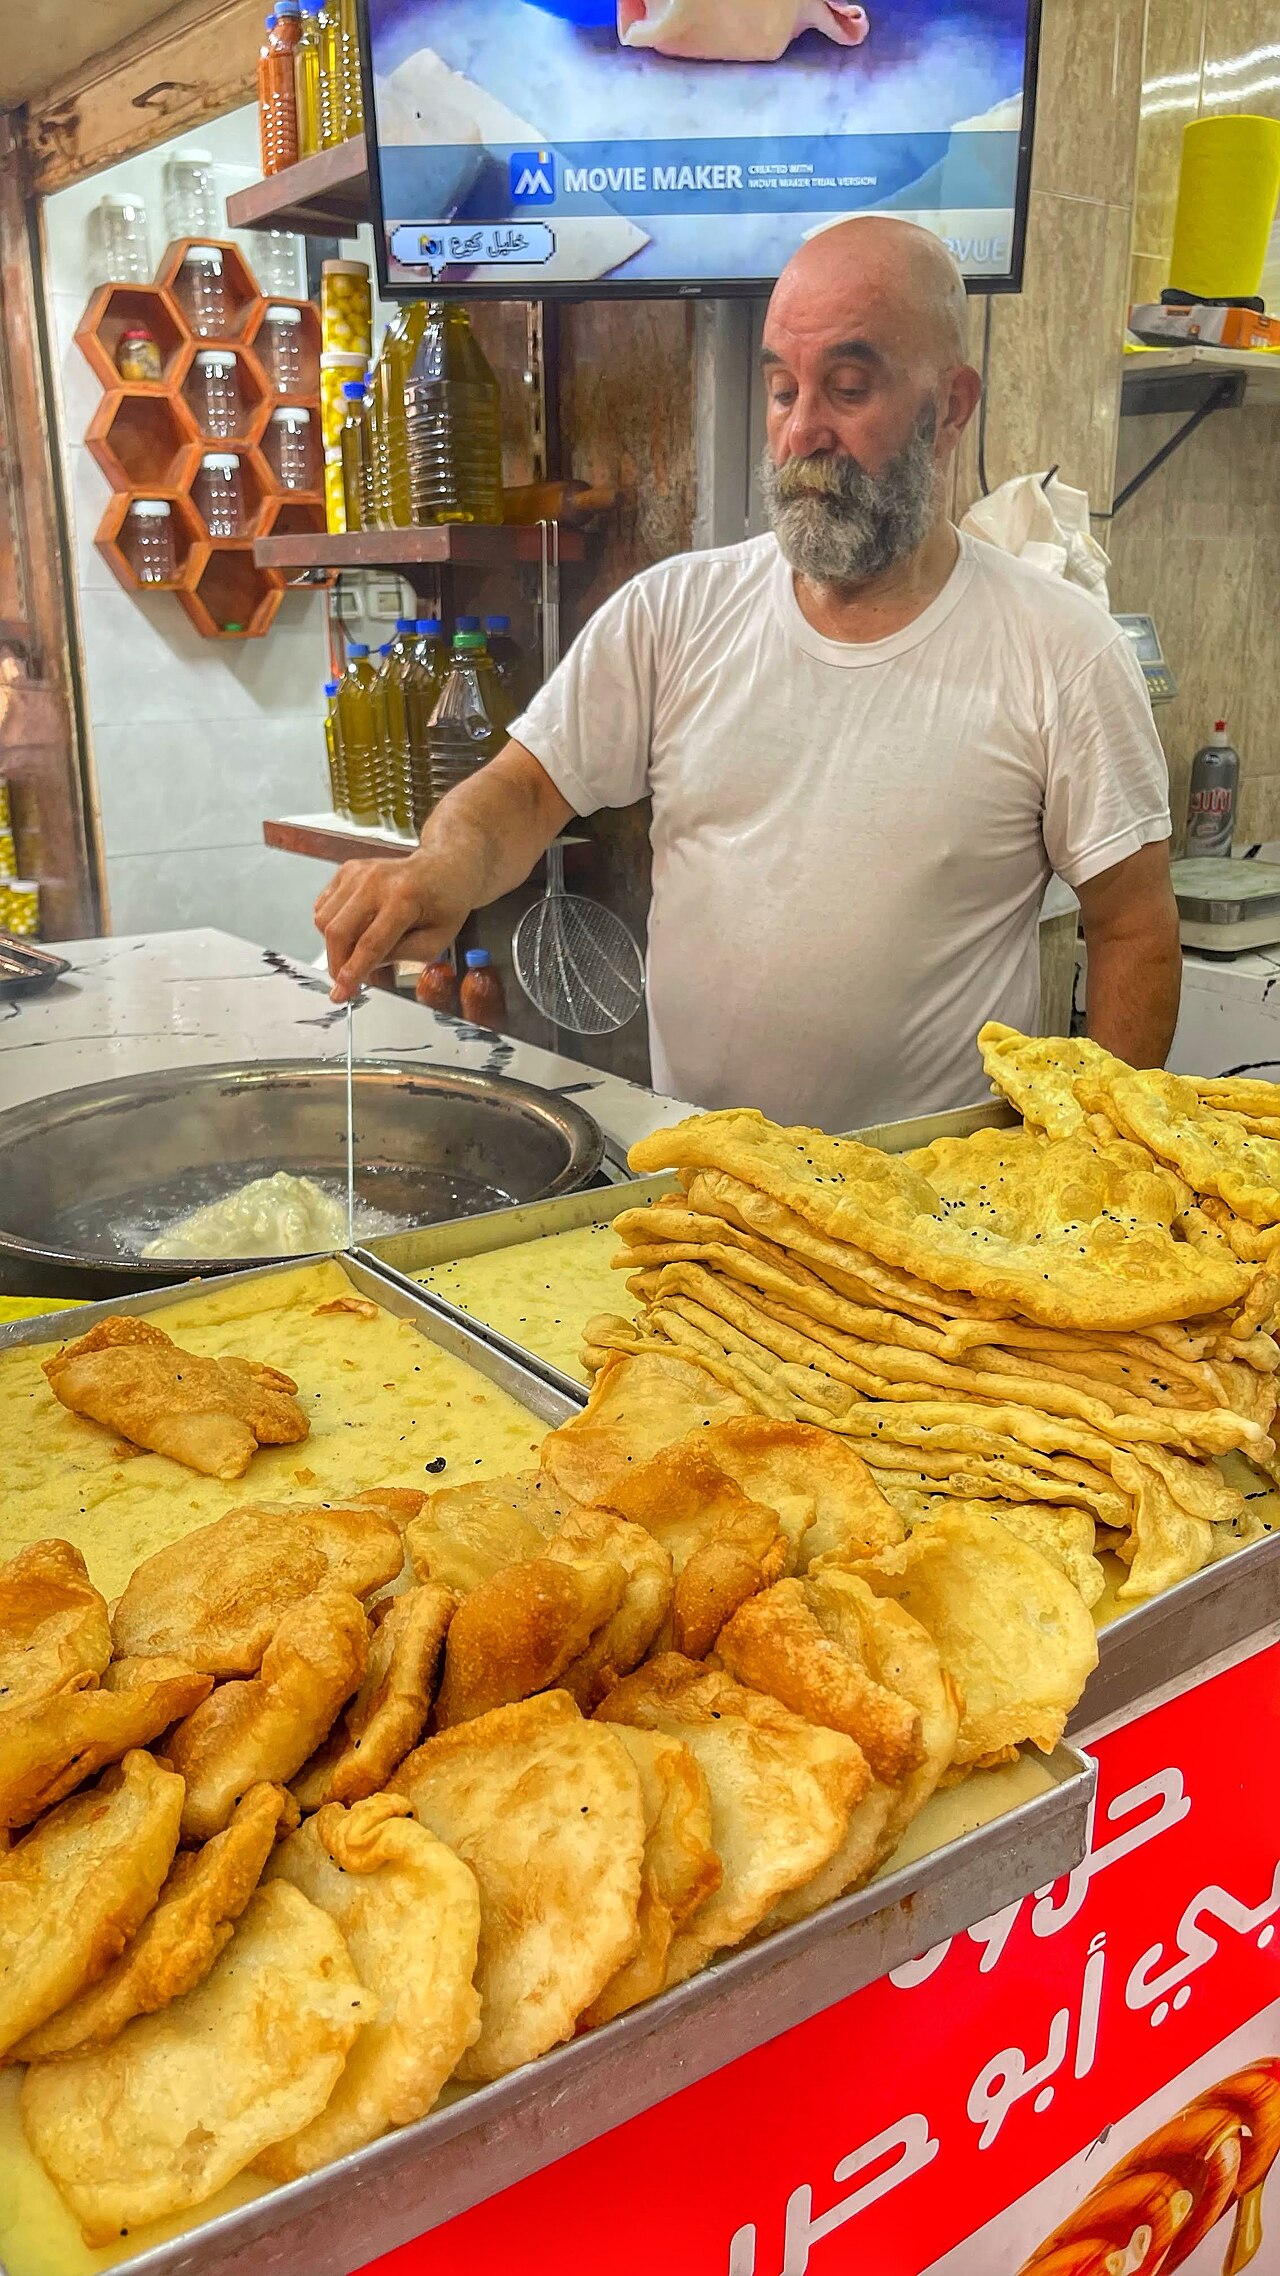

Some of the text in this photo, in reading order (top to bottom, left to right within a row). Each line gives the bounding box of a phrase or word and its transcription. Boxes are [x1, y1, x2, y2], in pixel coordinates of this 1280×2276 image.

[564, 167, 647, 192] MOVIE
[652, 165, 743, 190] MAKER
[967, 1932, 1107, 2149] أبو
